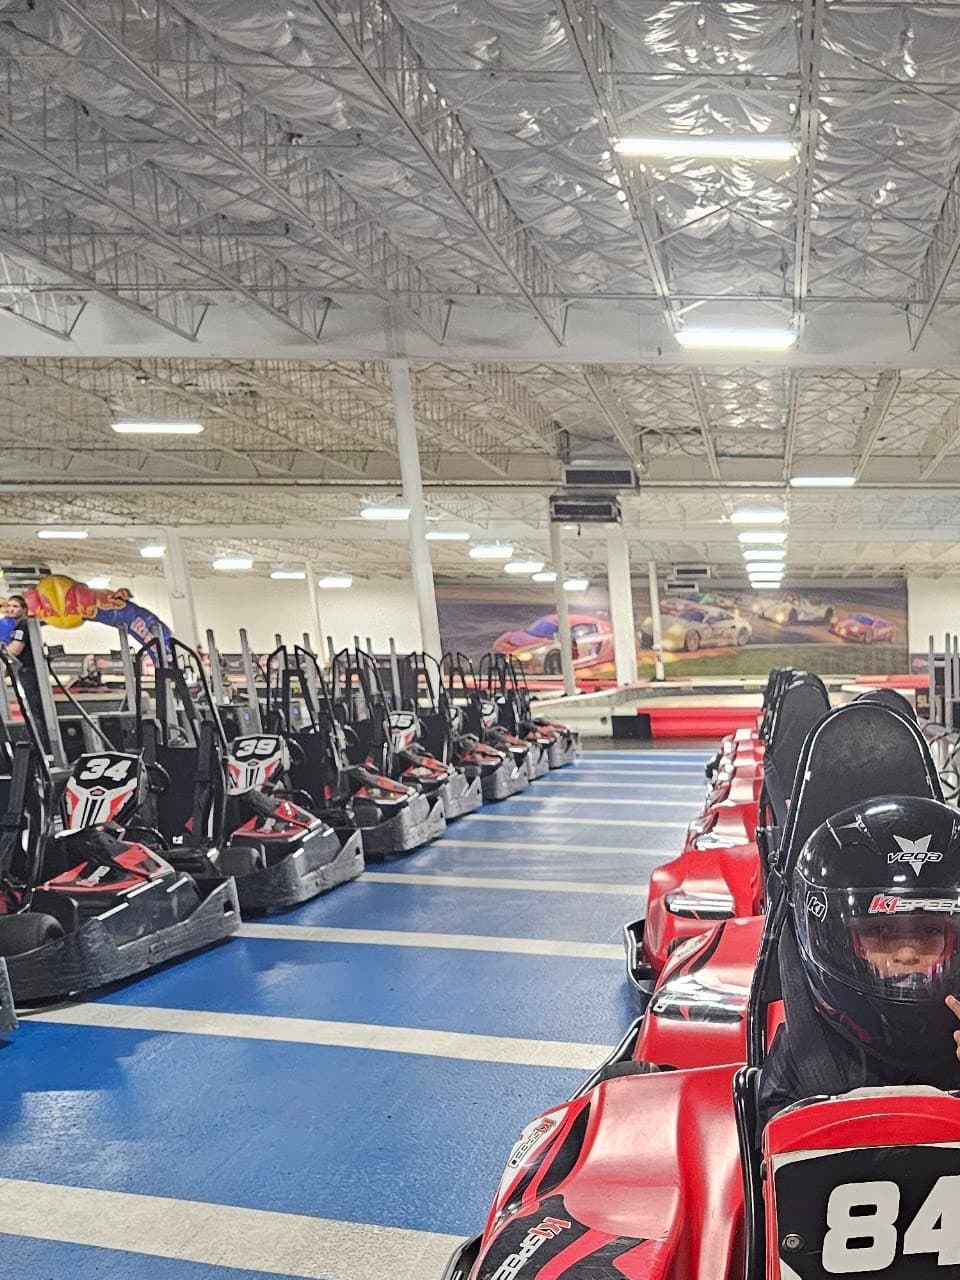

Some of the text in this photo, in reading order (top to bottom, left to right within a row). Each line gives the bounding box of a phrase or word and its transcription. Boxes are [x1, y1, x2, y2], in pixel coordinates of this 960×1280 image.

[236, 738, 277, 757] 39
[79, 758, 132, 782] 34
[887, 850, 944, 864] vega
